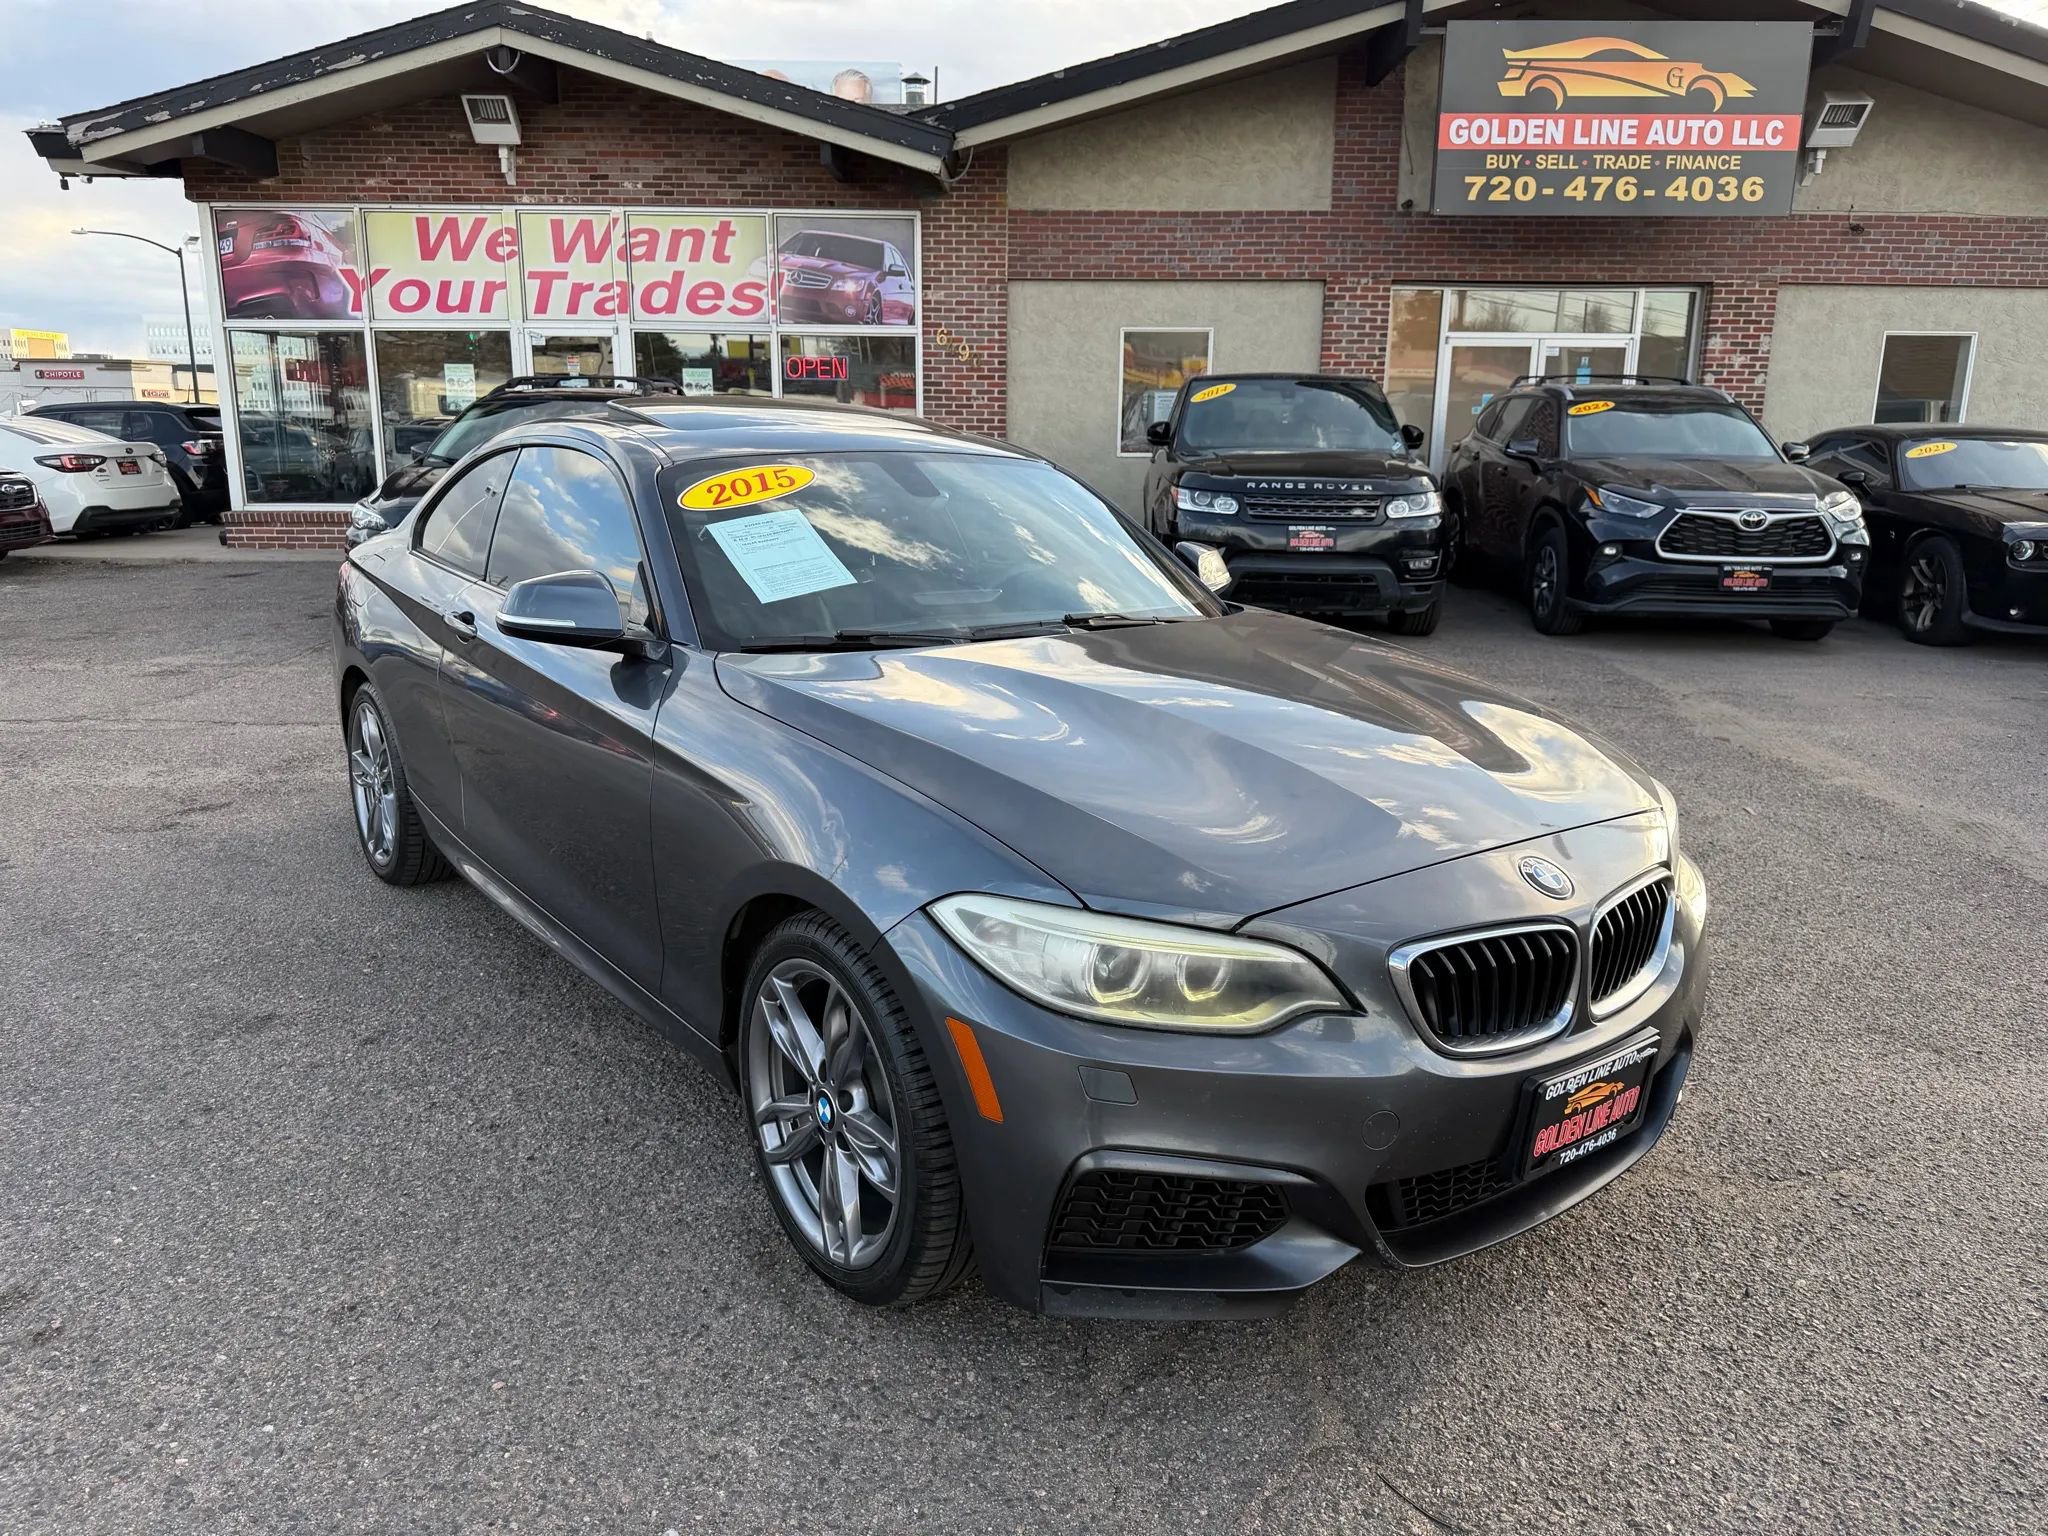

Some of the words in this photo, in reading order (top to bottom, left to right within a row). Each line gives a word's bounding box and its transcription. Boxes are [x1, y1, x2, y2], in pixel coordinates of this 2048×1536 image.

[1666, 67, 1685, 88] G
[1449, 118, 1565, 145] GOLDEN
[1573, 119, 1639, 145] LINE
[1645, 119, 1724, 146] AUTO
[1732, 119, 1785, 146] LLC
[1486, 154, 1523, 169] BUY
[1535, 154, 1579, 170] SELL
[1593, 154, 1651, 170] TRADE
[1665, 155, 1742, 170] FINANCE
[415, 216, 519, 263] We
[549, 217, 737, 264] Want
[339, 268, 508, 314] Your
[527, 269, 785, 317] Trades!
[786, 357, 847, 379] OPEN
[1574, 402, 1611, 414] 2024
[1917, 443, 1946, 456] 2021
[706, 468, 796, 506] 2015
[1313, 483, 1373, 491] ROVER
[1587, 1061, 1613, 1082] LINE
[1611, 1050, 1638, 1073] AUTO
[1533, 1113, 1585, 1157] GOLDEN
[1583, 1098, 1612, 1136] LINE
[1609, 1085, 1641, 1121] AUTO
[1560, 1128, 1617, 1165] 720-476-4036
